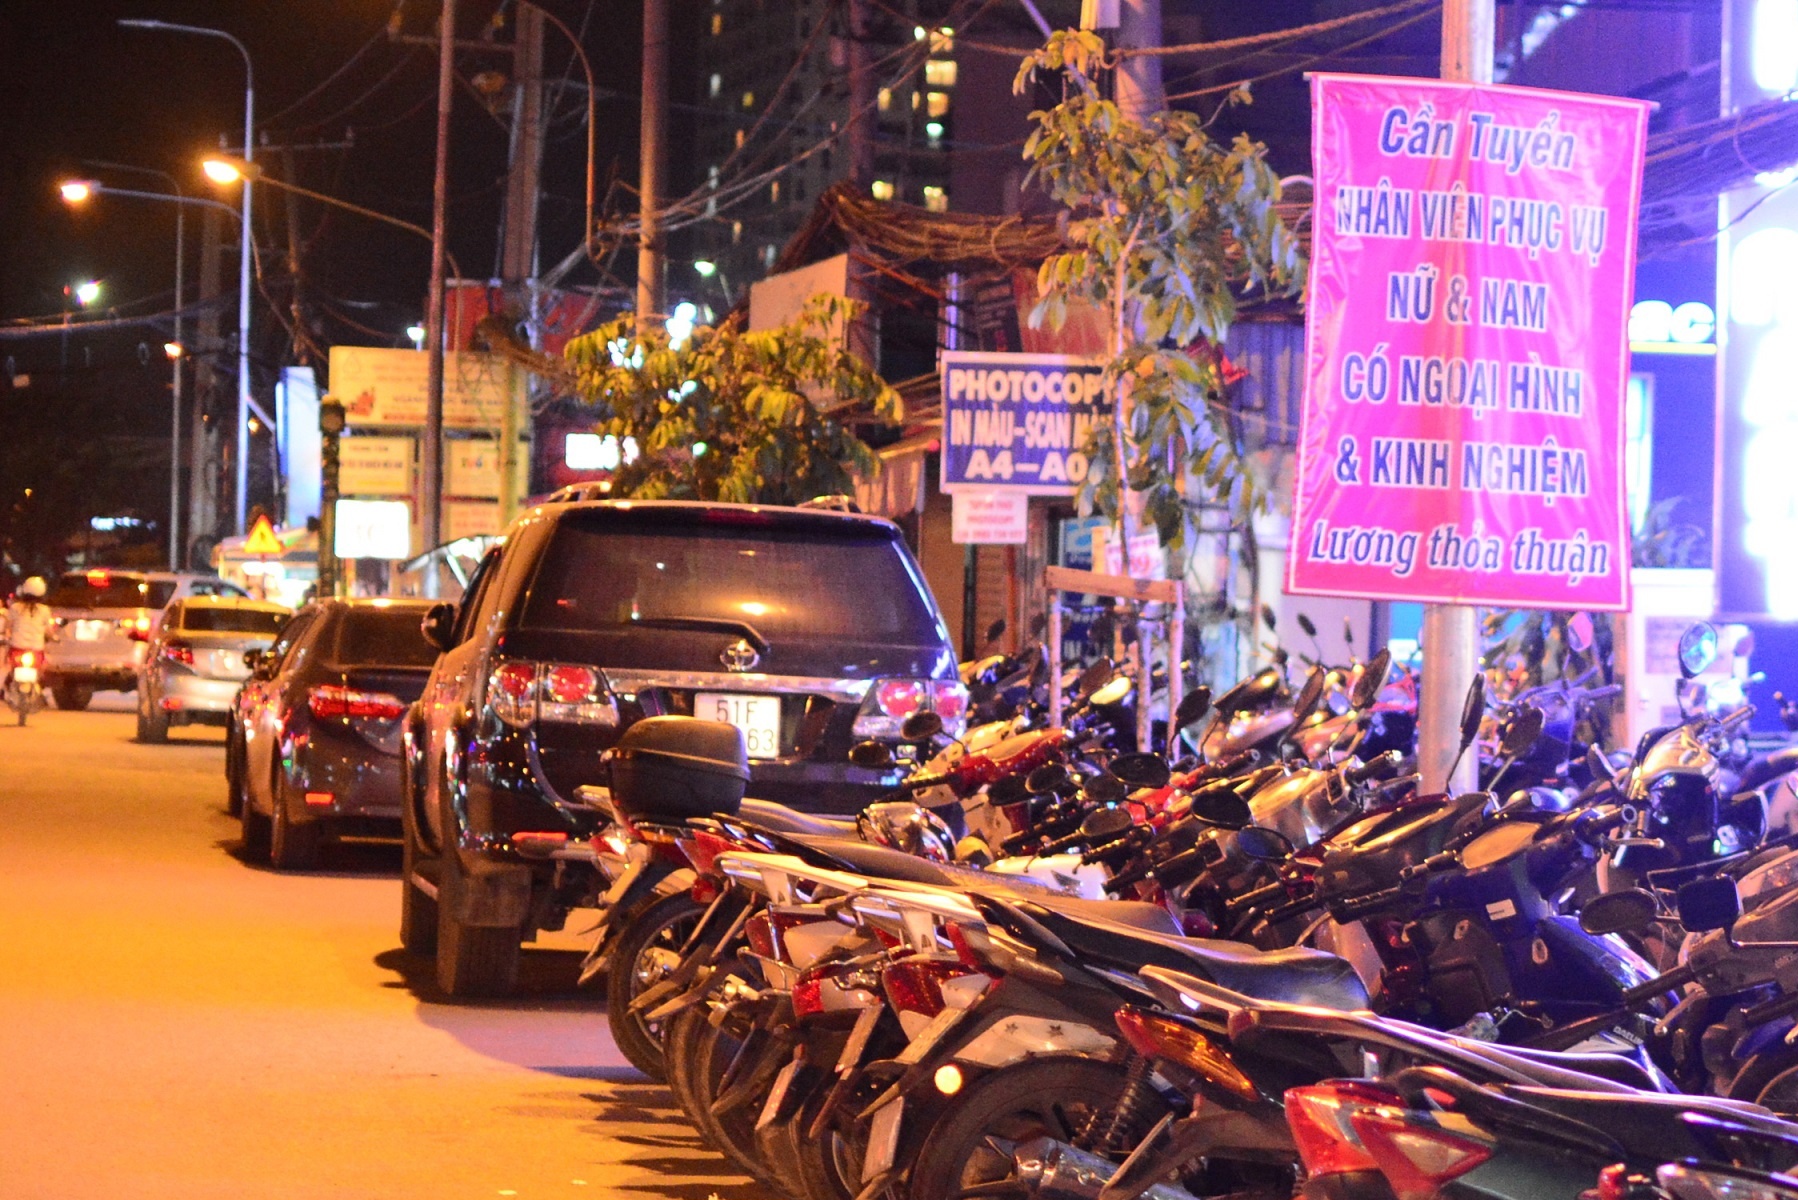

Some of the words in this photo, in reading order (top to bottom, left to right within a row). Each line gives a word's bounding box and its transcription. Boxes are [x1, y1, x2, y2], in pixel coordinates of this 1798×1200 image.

[1380, 105, 1453, 156] Cần
[1470, 111, 1575, 173] Tuyển
[1337, 182, 1410, 236] NHÂN
[1421, 184, 1484, 241] VIÊN
[1490, 198, 1560, 258] PHỤC
[1571, 207, 1607, 267] VỤ
[1388, 265, 1435, 321] NỮ
[1446, 276, 1470, 323] &
[1482, 278, 1547, 330] NAM
[1343, 344, 1390, 402] CÓ
[1400, 357, 1499, 421] NGOẠI
[1509, 355, 1582, 415] HÌNH
[950, 409, 971, 446] IN
[1335, 437, 1359, 484] &
[1372, 439, 1449, 487] KINH
[1463, 438, 1588, 505] NGHIỆM
[1311, 520, 1417, 575] Lương
[1510, 535, 1609, 585] thuận
[716, 699, 758, 724] 51F
